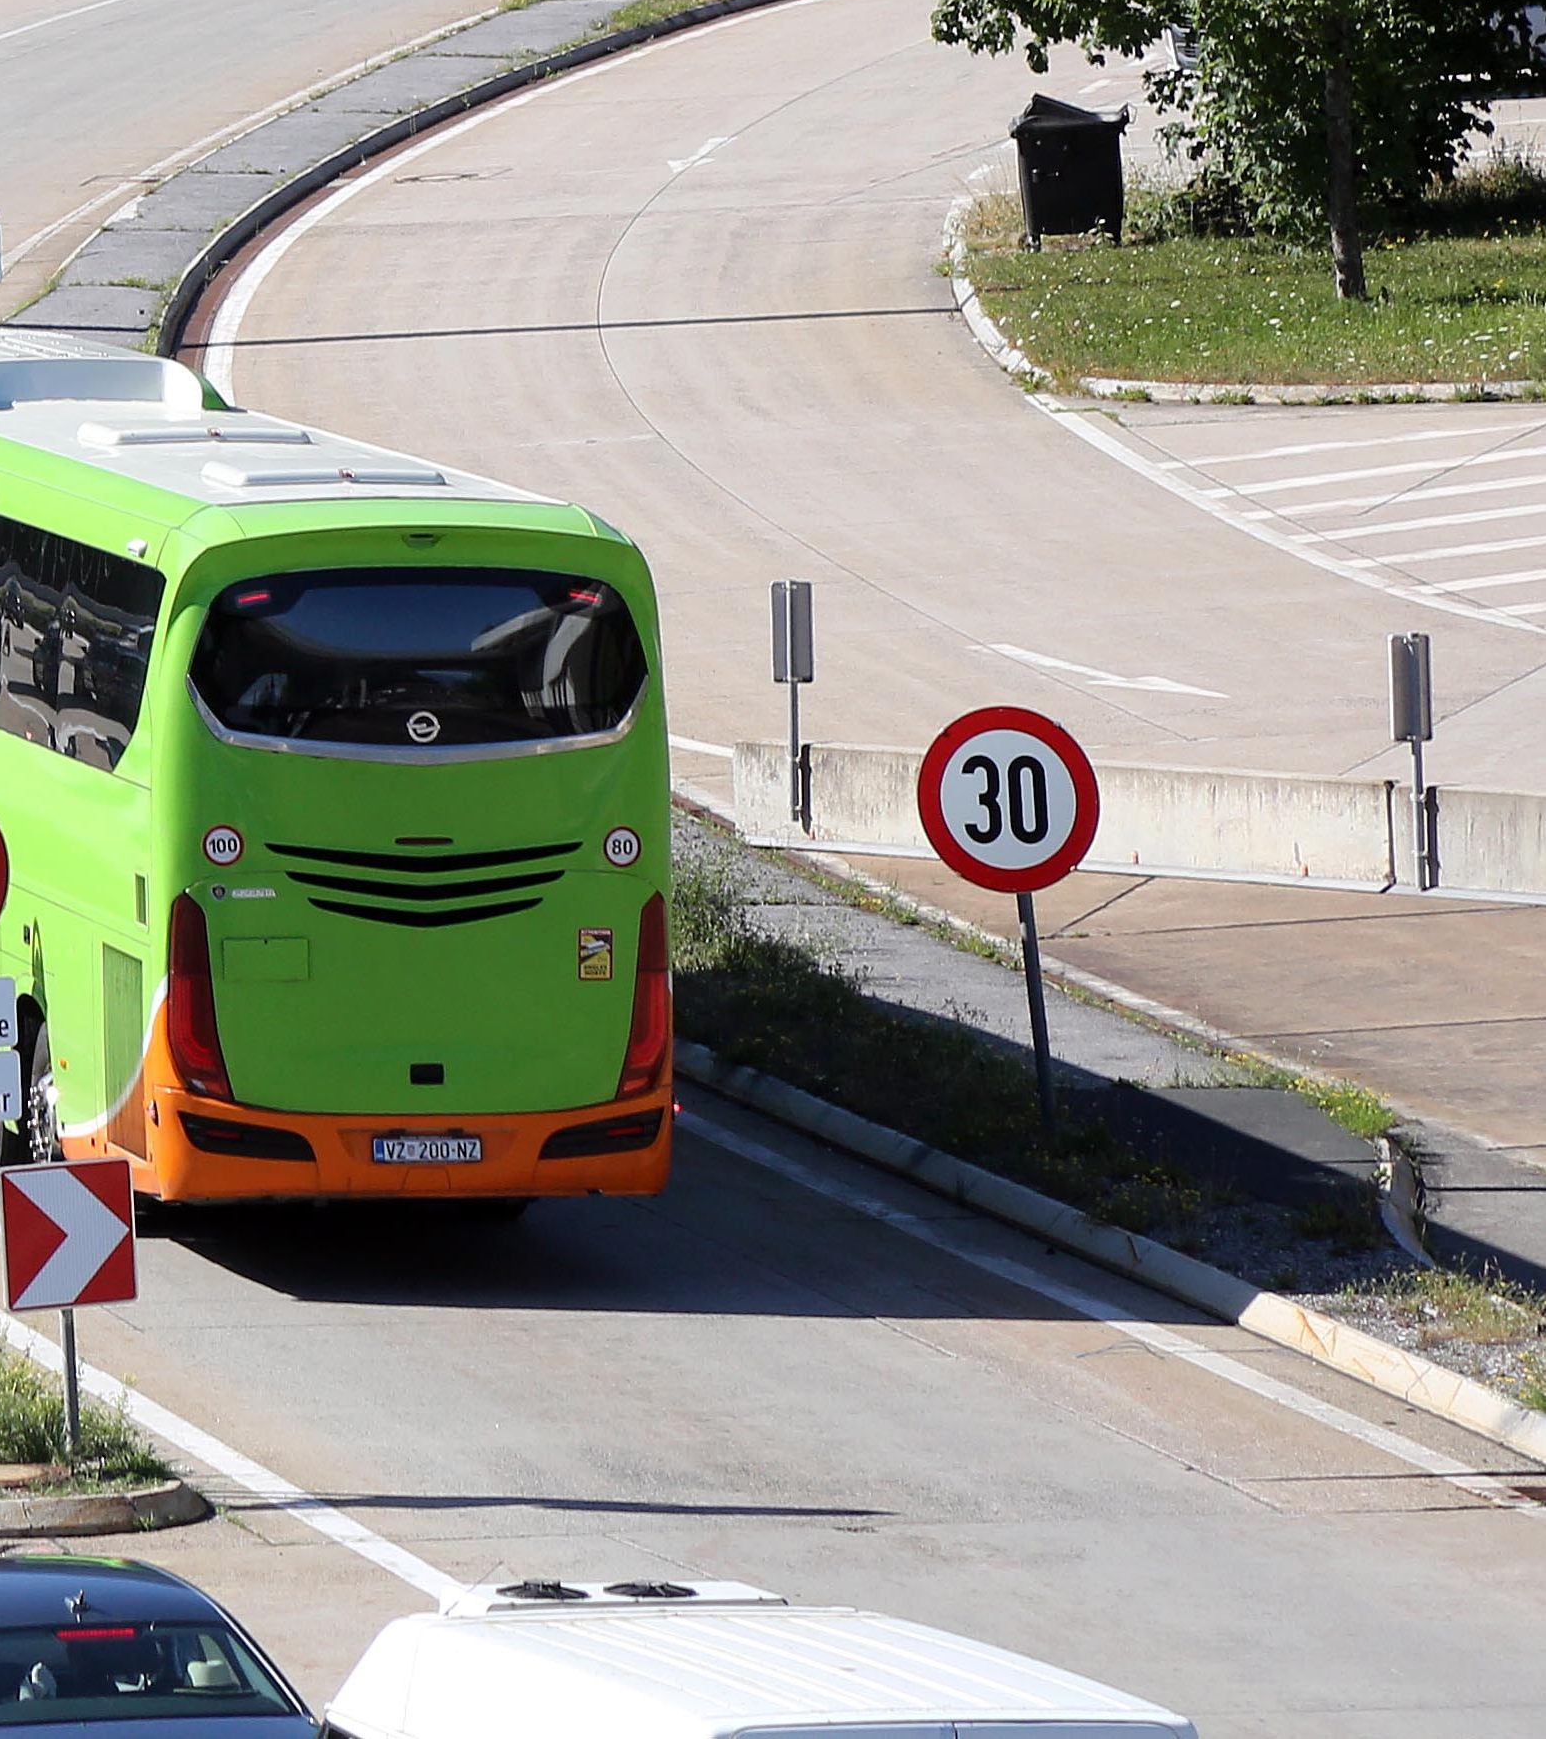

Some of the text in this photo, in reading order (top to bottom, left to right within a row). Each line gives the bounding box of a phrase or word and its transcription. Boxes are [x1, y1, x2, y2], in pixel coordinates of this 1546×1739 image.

[961, 755, 1049, 845] 30
[208, 838, 238, 854] 100
[611, 838, 634, 856] 80
[385, 1142, 406, 1159] VZ
